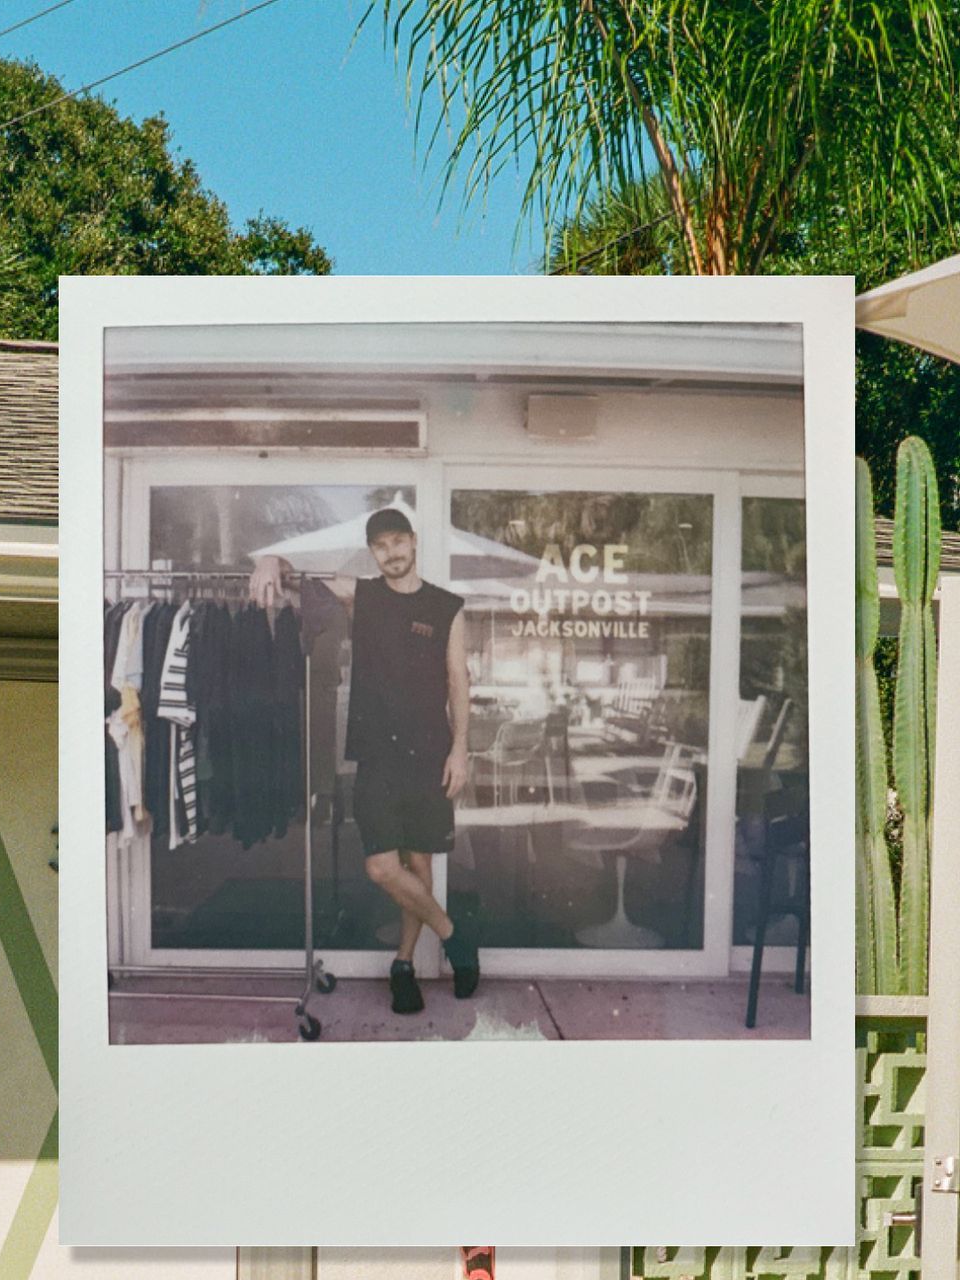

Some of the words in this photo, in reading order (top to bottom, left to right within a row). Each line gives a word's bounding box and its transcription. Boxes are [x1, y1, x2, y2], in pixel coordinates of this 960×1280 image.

[536, 543, 629, 584] ACE
[510, 588, 652, 616] OUTPOST
[512, 620, 649, 638] JACKSONVILLE
